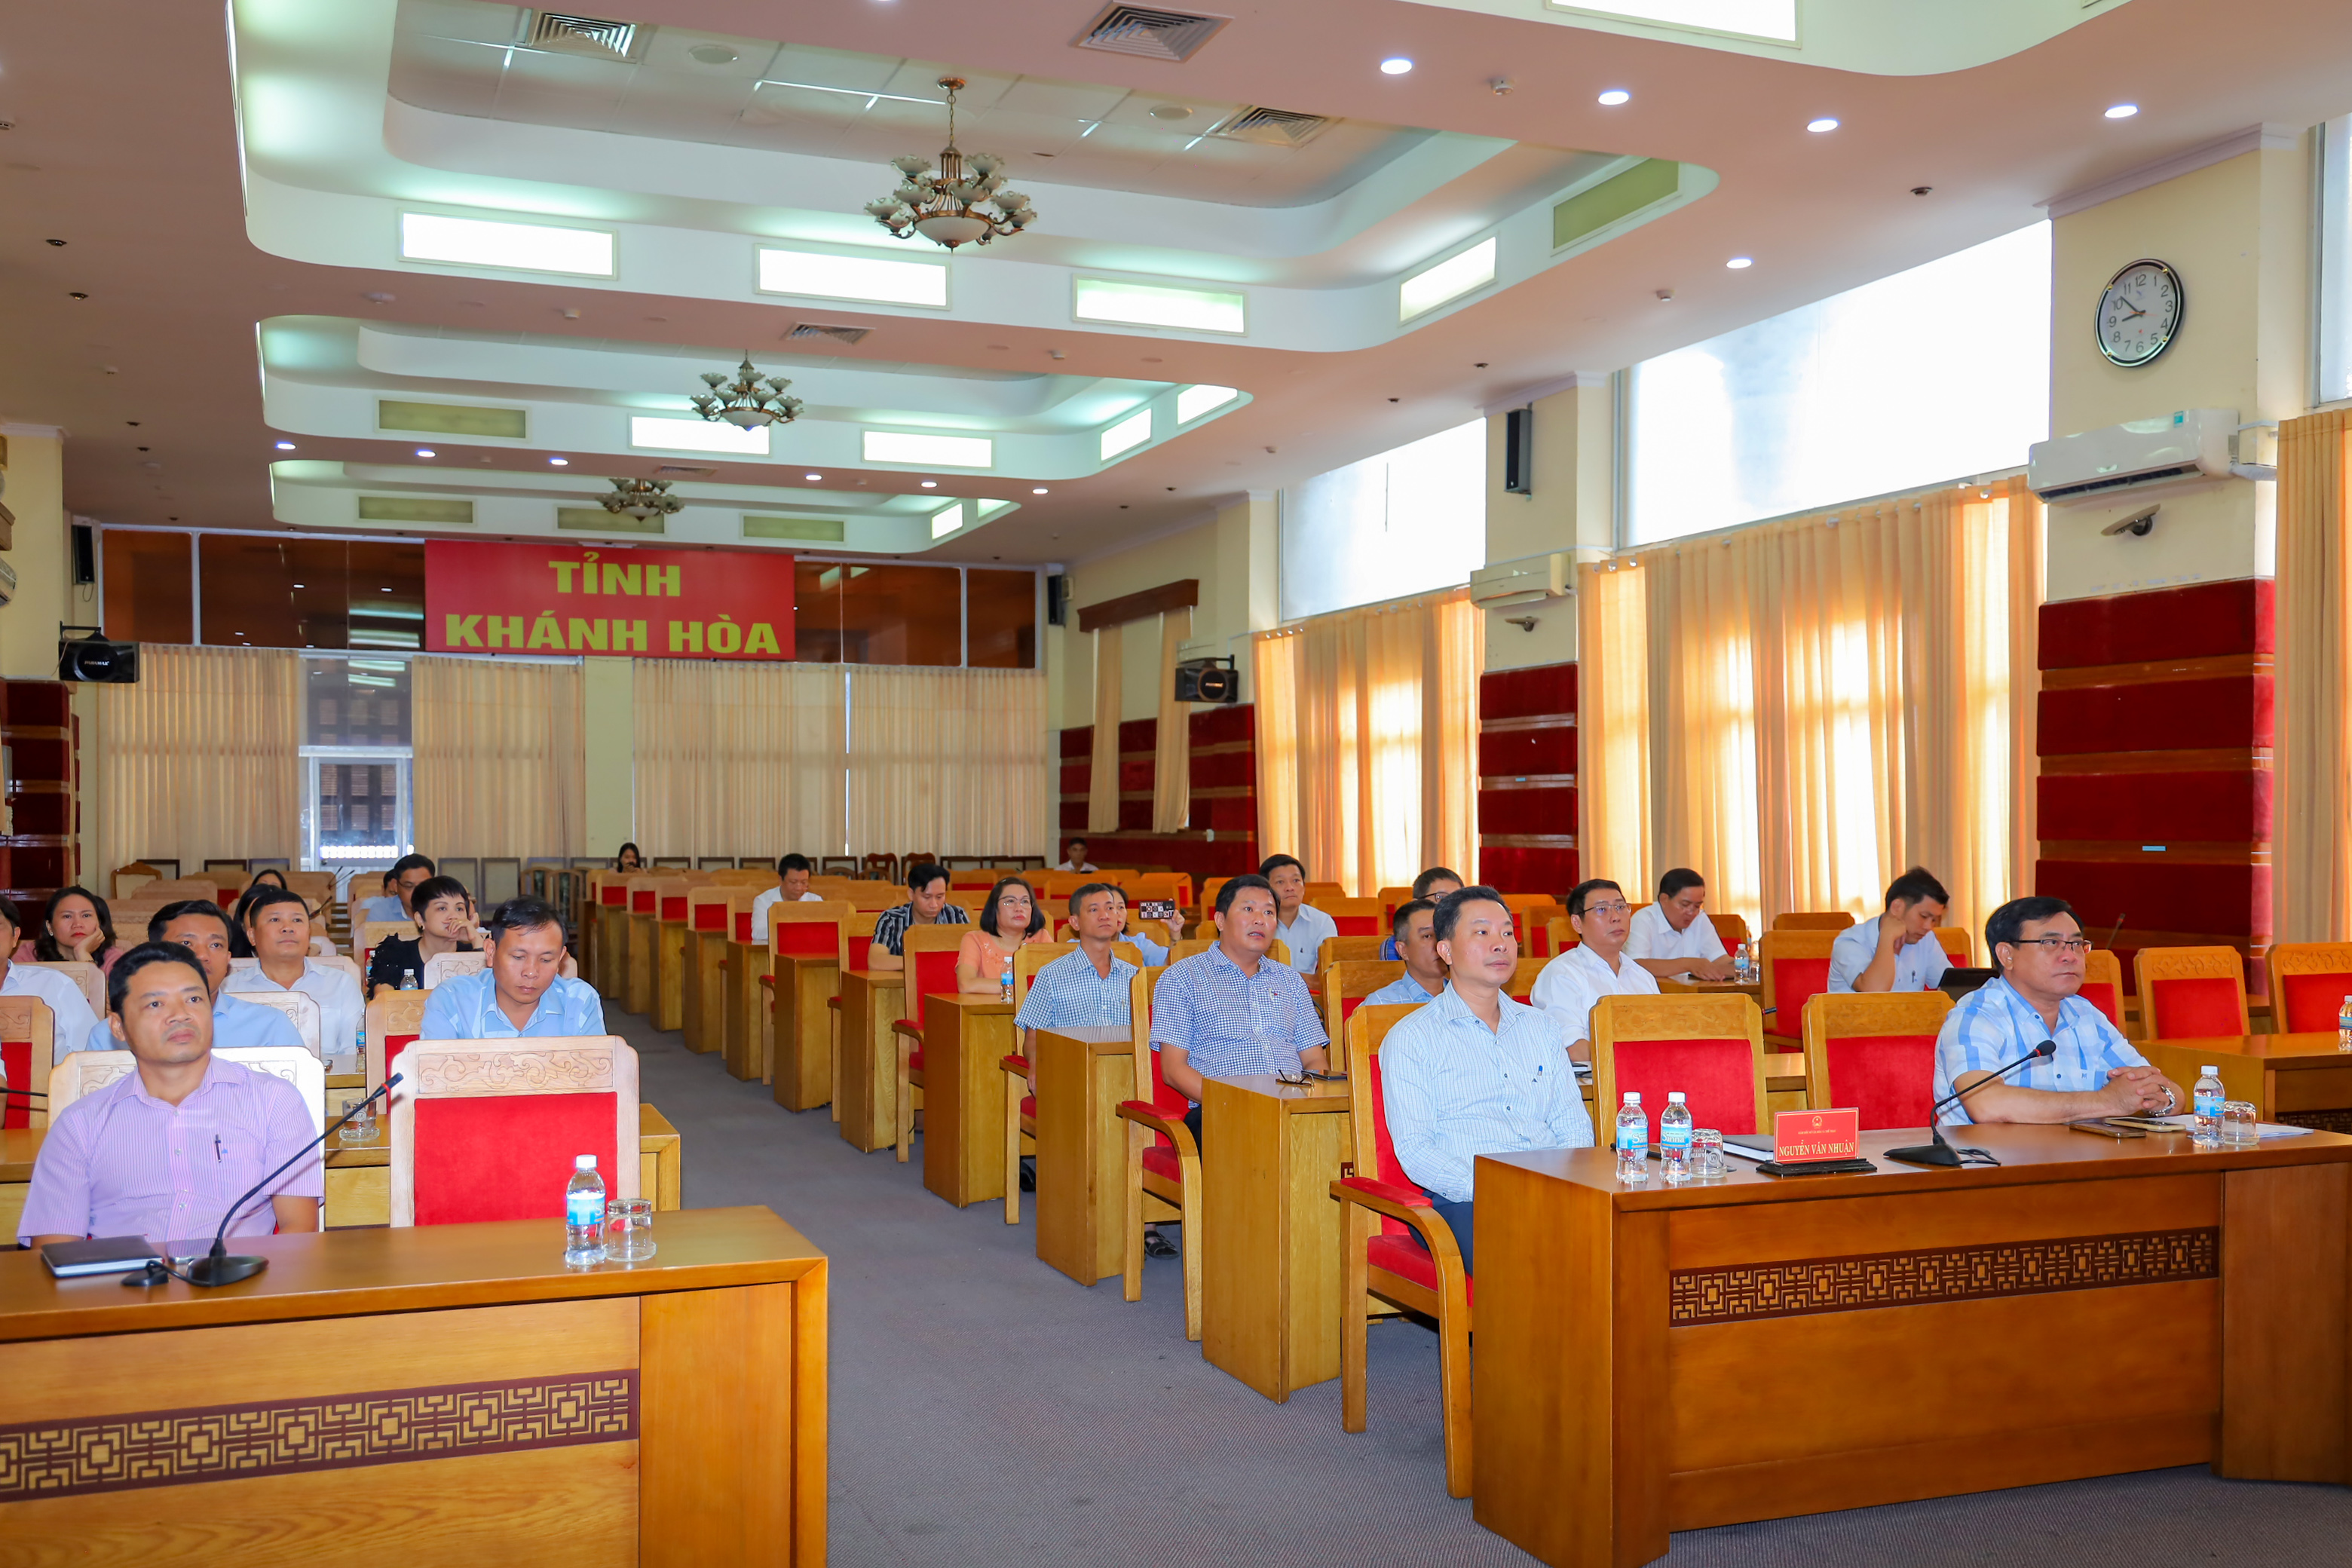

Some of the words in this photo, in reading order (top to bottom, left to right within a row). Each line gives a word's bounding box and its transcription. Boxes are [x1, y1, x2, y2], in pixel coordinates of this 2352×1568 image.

[2135, 274, 2147, 287] 12
[2154, 274, 2158, 286] 1
[2123, 282, 2131, 295] 11
[2161, 284, 2170, 298] 2
[2112, 298, 2124, 311] 10
[2164, 300, 2173, 313] 3
[2109, 316, 2117, 328] 9
[2161, 317, 2168, 329] 4
[2113, 331, 2121, 343] 8
[2150, 332, 2159, 345] 5
[2124, 340, 2131, 352] 7
[2136, 341, 2144, 353] 6
[548, 551, 681, 597] TỈNH
[446, 610, 648, 651] KHÁNH
[669, 614, 781, 654] HÒA
[1778, 1139, 1810, 1157] NGUYỄN
[1811, 1141, 1827, 1155] VĂN
[1828, 1139, 1854, 1156] NHUẬN
